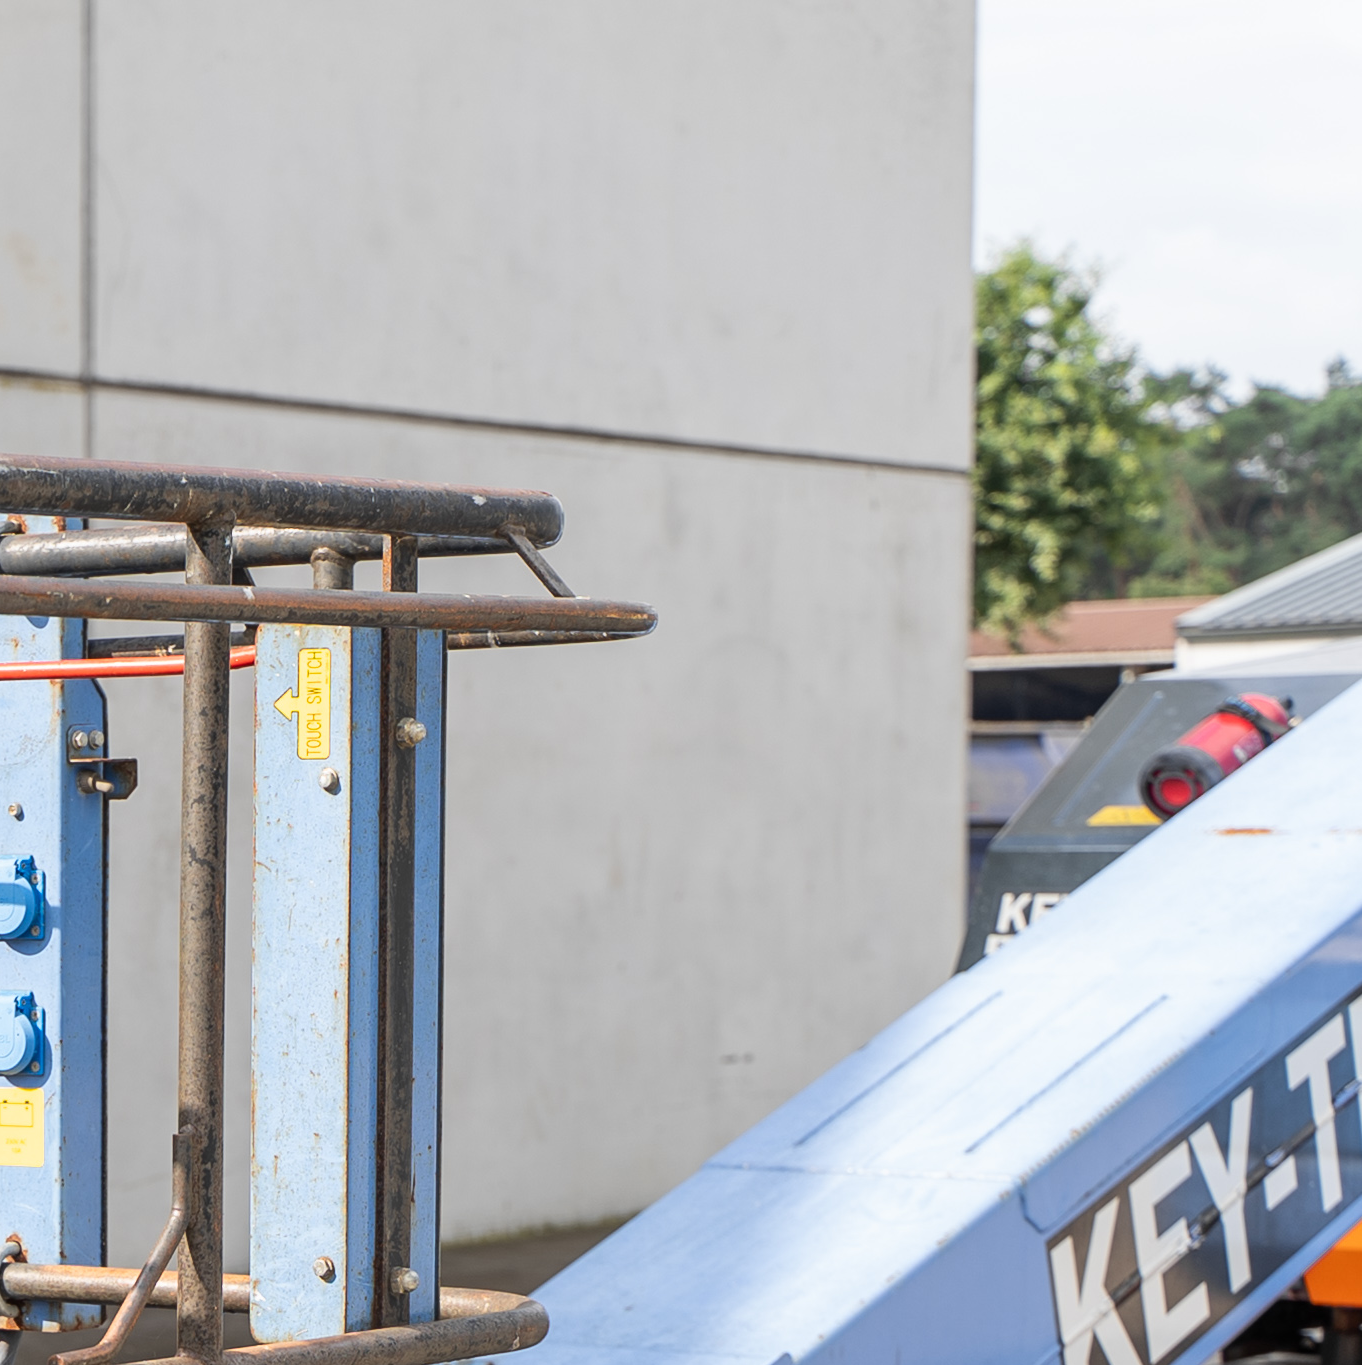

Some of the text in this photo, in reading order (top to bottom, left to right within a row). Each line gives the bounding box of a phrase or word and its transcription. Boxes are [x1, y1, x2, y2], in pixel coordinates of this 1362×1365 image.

[306, 651, 322, 756] TOUCH SWITCH
[995, 892, 1069, 934] KE
